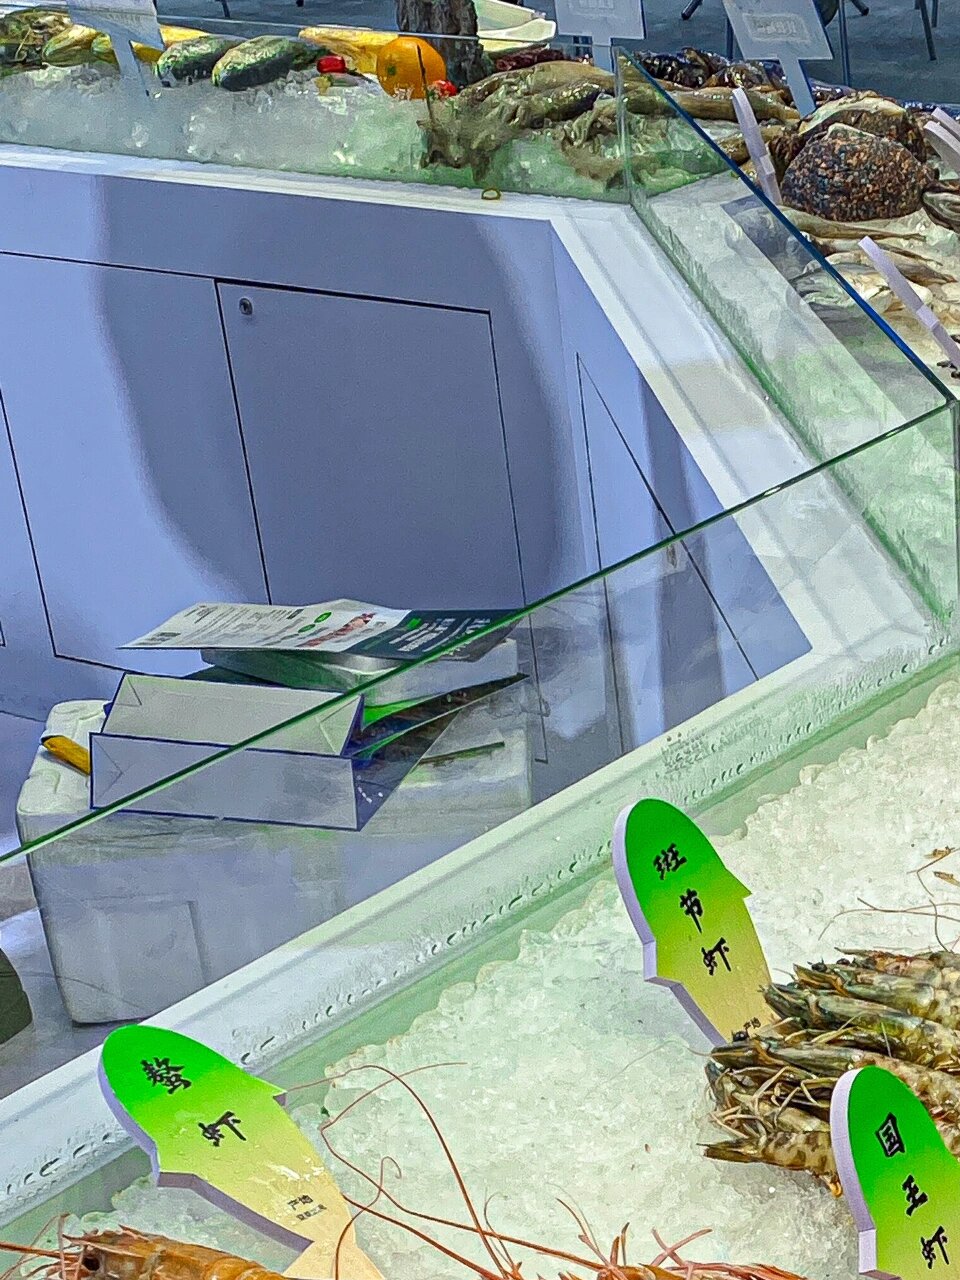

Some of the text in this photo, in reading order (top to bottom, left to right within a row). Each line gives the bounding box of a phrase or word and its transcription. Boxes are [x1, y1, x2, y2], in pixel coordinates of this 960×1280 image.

[653, 843, 732, 975] 斑节虾
[141, 1057, 246, 1147] 螯虾
[875, 1112, 950, 1269] 国王虾
